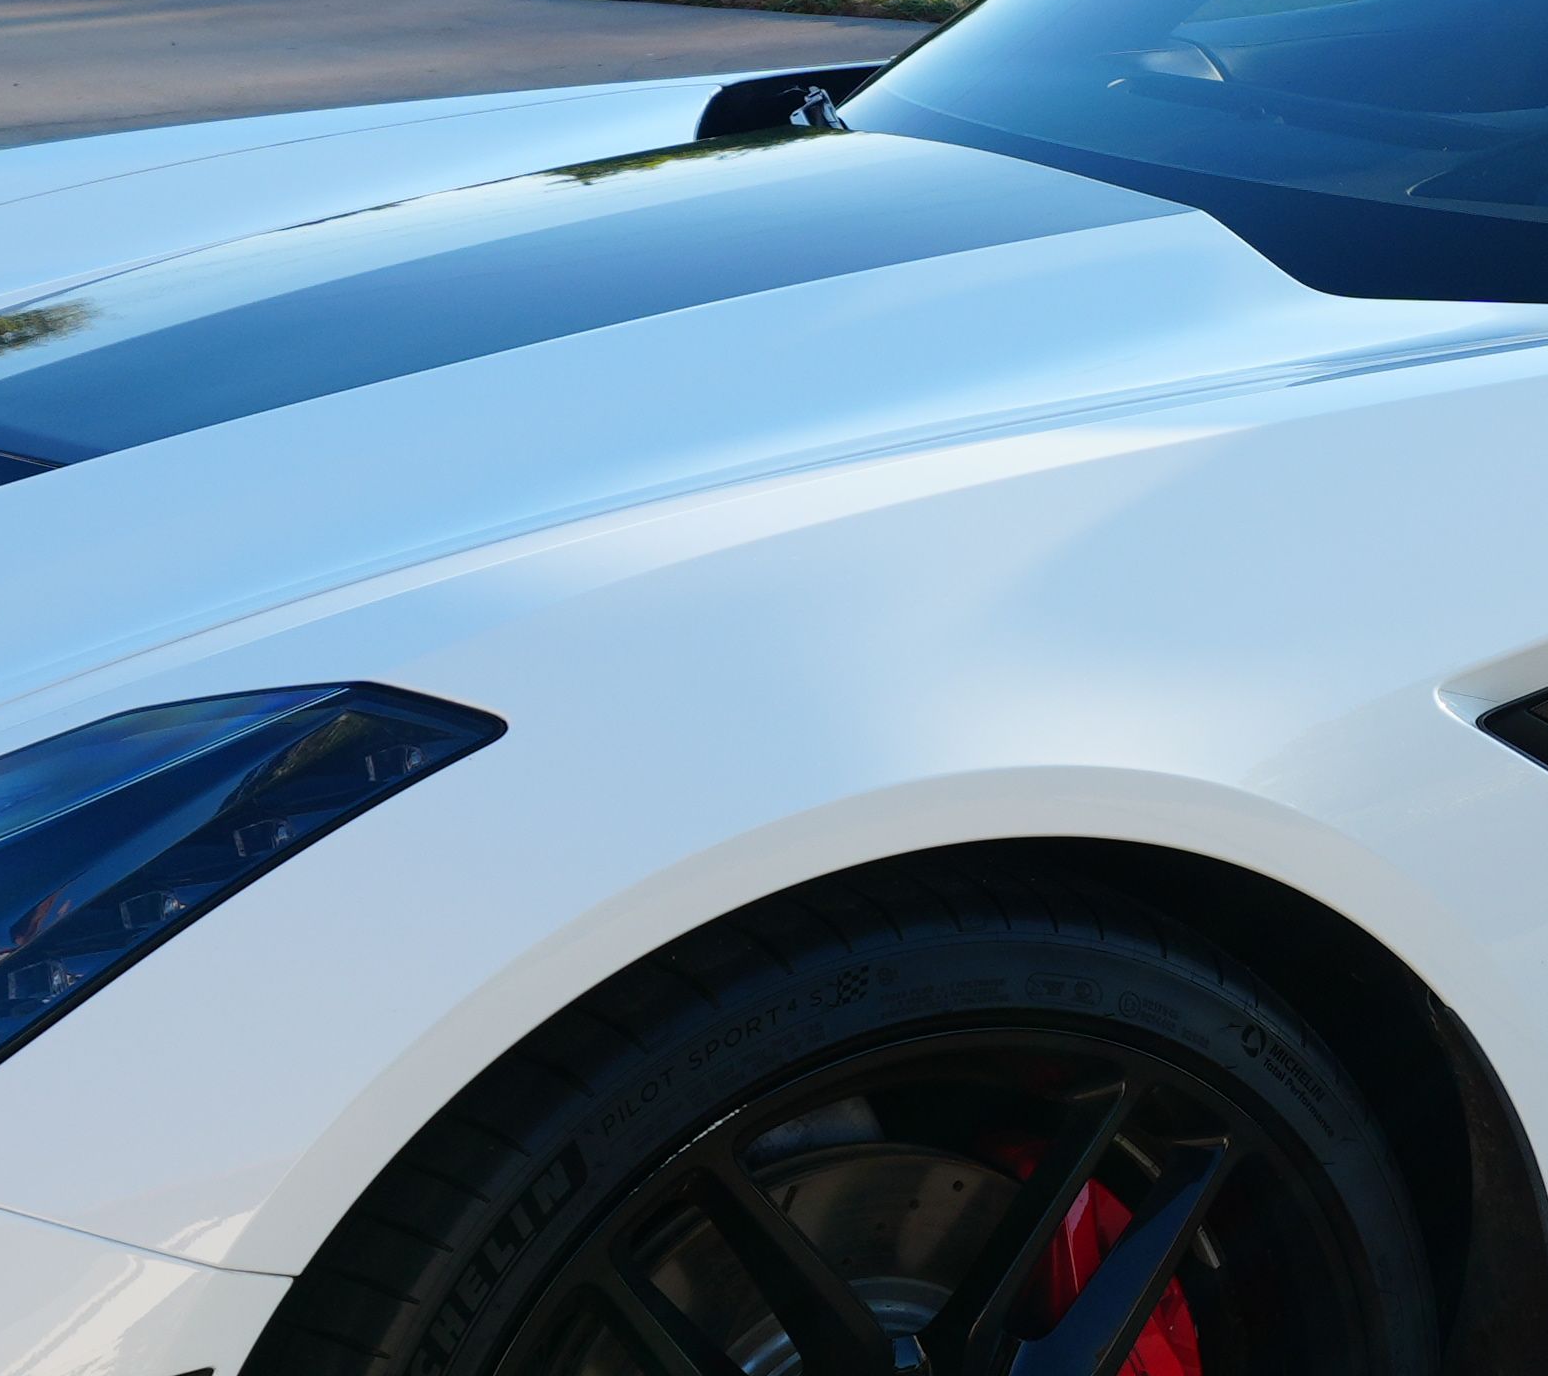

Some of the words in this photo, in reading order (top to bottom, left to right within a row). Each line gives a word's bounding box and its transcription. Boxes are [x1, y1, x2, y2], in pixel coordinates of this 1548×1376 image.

[602, 1066, 675, 1136] PILOT
[688, 1008, 781, 1070] SPORT
[787, 998, 798, 1011] 4
[809, 990, 824, 1007] S
[1263, 1057, 1286, 1083] Total
[1284, 1077, 1335, 1138] Performance
[1268, 1044, 1326, 1104] MICHELIN
